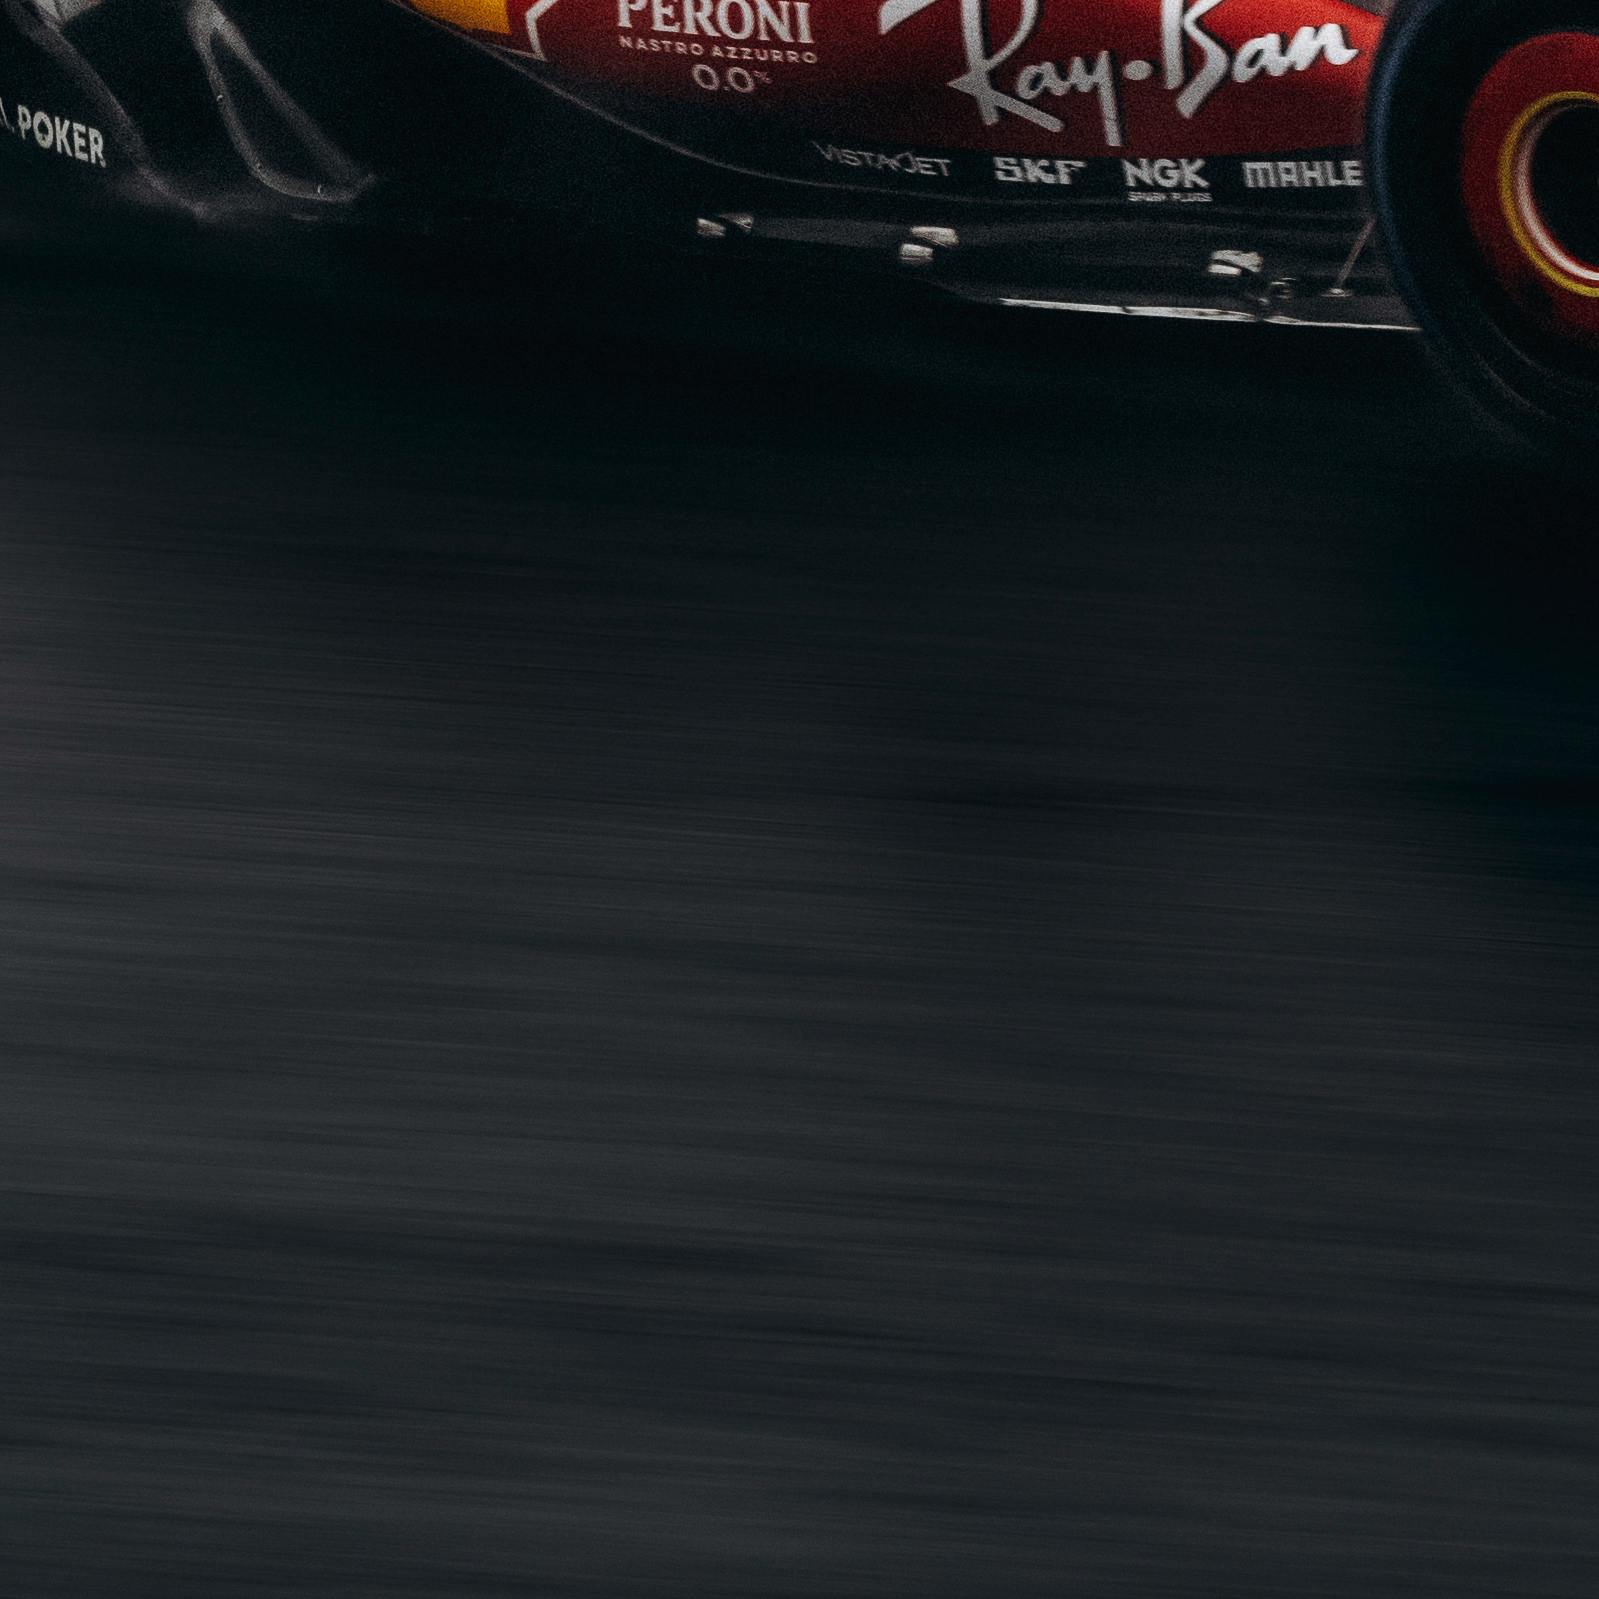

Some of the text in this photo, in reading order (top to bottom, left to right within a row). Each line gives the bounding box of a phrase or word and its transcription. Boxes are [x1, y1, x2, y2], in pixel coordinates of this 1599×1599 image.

[618, 35, 819, 65] NASTRO AZZURRO
[17, 104, 107, 169] POKER
[994, 157, 1087, 185] SKF
[1121, 158, 1211, 188] NGK
[1242, 159, 1364, 188] MAHLE
